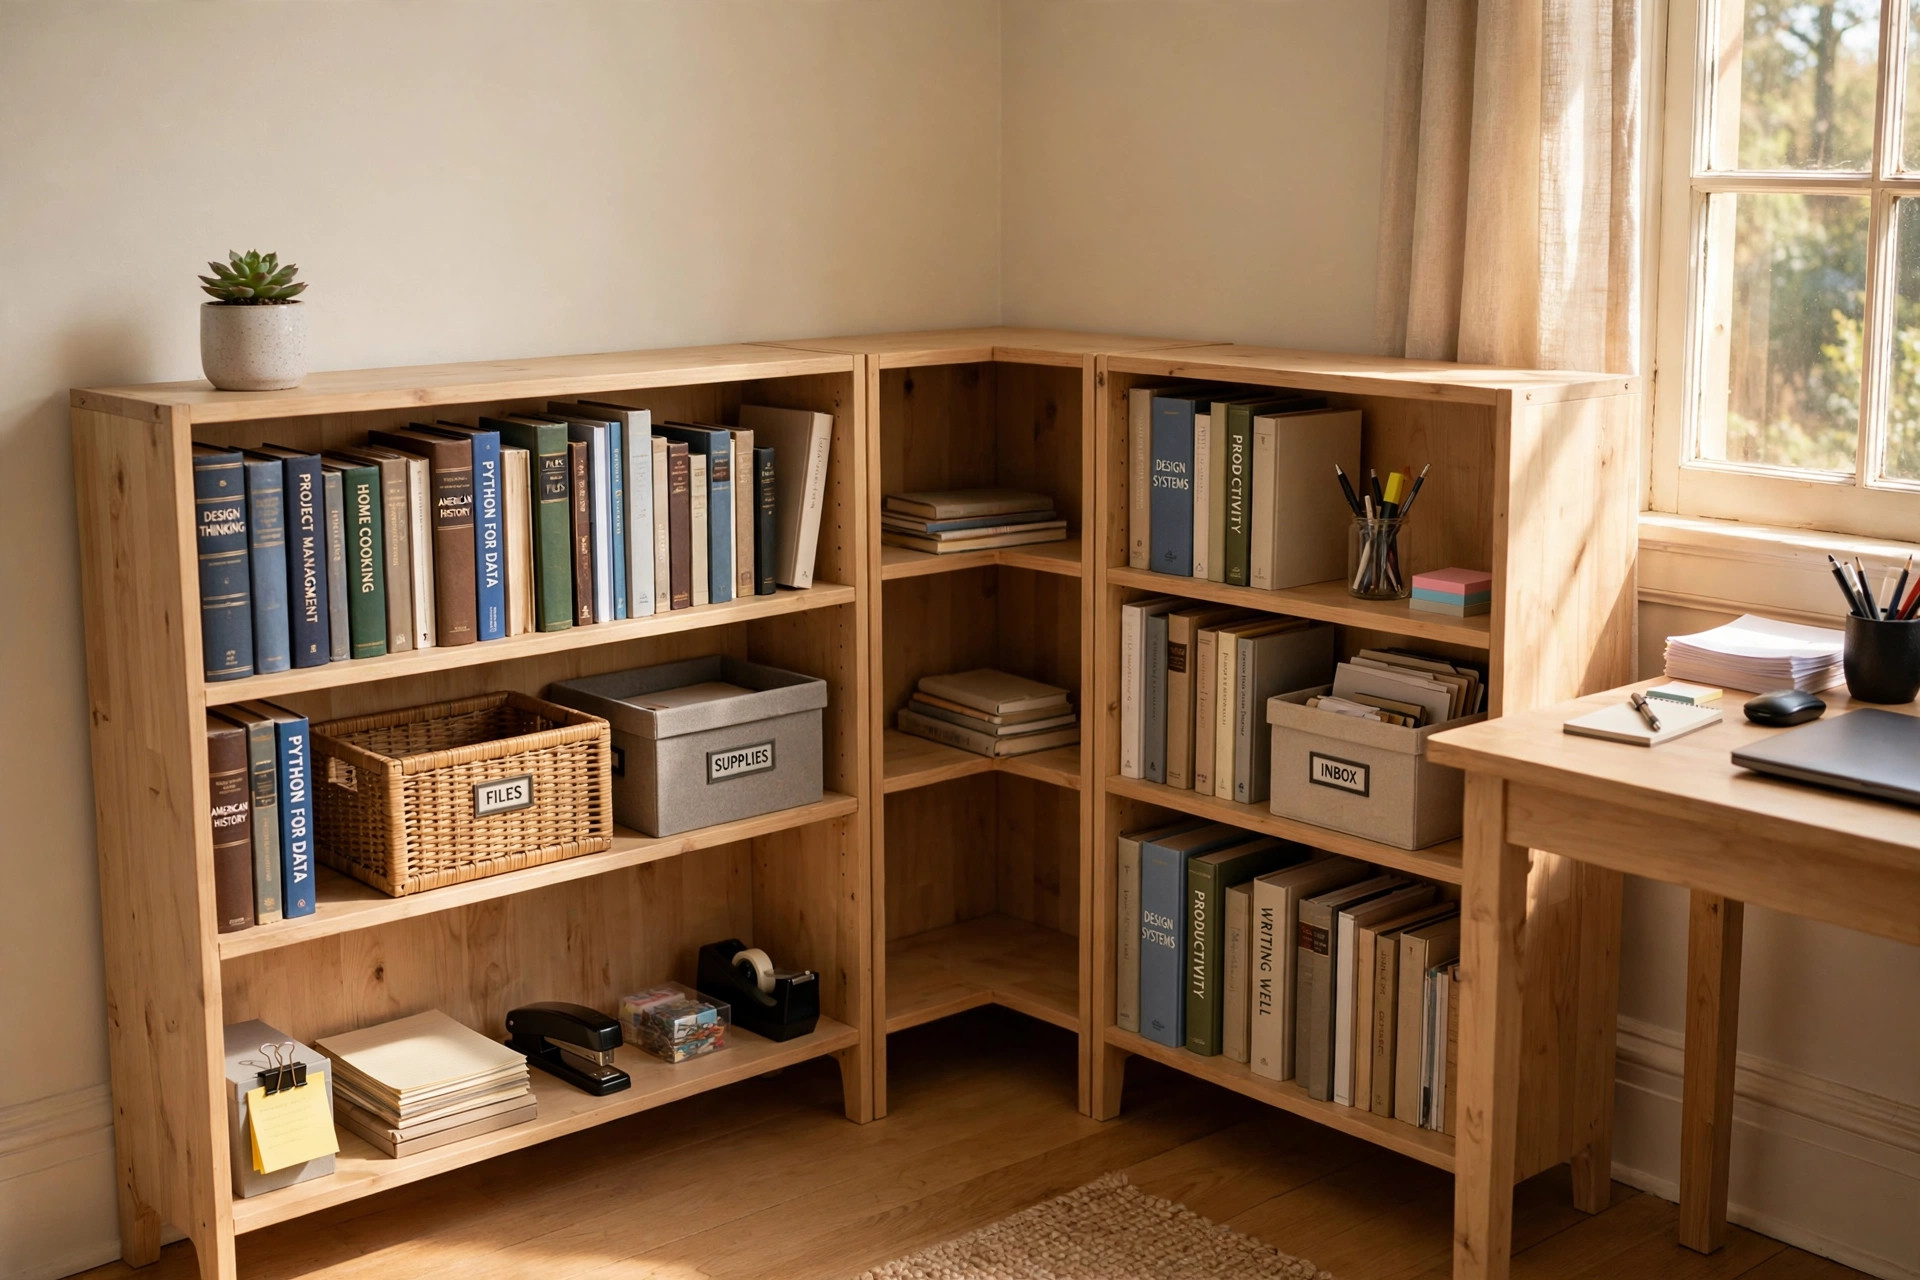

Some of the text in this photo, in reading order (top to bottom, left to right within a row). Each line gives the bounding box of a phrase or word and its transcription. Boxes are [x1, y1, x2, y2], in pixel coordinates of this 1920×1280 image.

[1155, 458, 1186, 473] DESIGN
[1152, 475, 1189, 490] SYSTEMS
[1231, 434, 1243, 534] PRODCTIVITY
[299, 473, 314, 532] PROJECT
[440, 507, 470, 518] HISTORY
[204, 507, 240, 522] DESIGN
[482, 460, 499, 588] PYTHON FOR DATA
[199, 522, 245, 536] THINKING
[357, 484, 374, 593] HOME COOKING
[714, 749, 769, 772] SUPPLIES
[1321, 762, 1357, 785] INBOX
[486, 785, 522, 805] FILES
[214, 813, 247, 827] HISTORY
[288, 735, 307, 883] PYTHON FOR DATA
[1144, 910, 1173, 930] DESIGN
[1142, 926, 1175, 949] SYSTEMS
[1193, 890, 1205, 999] PRODUCTIVITY
[1259, 907, 1273, 1016] WRITING WELL
